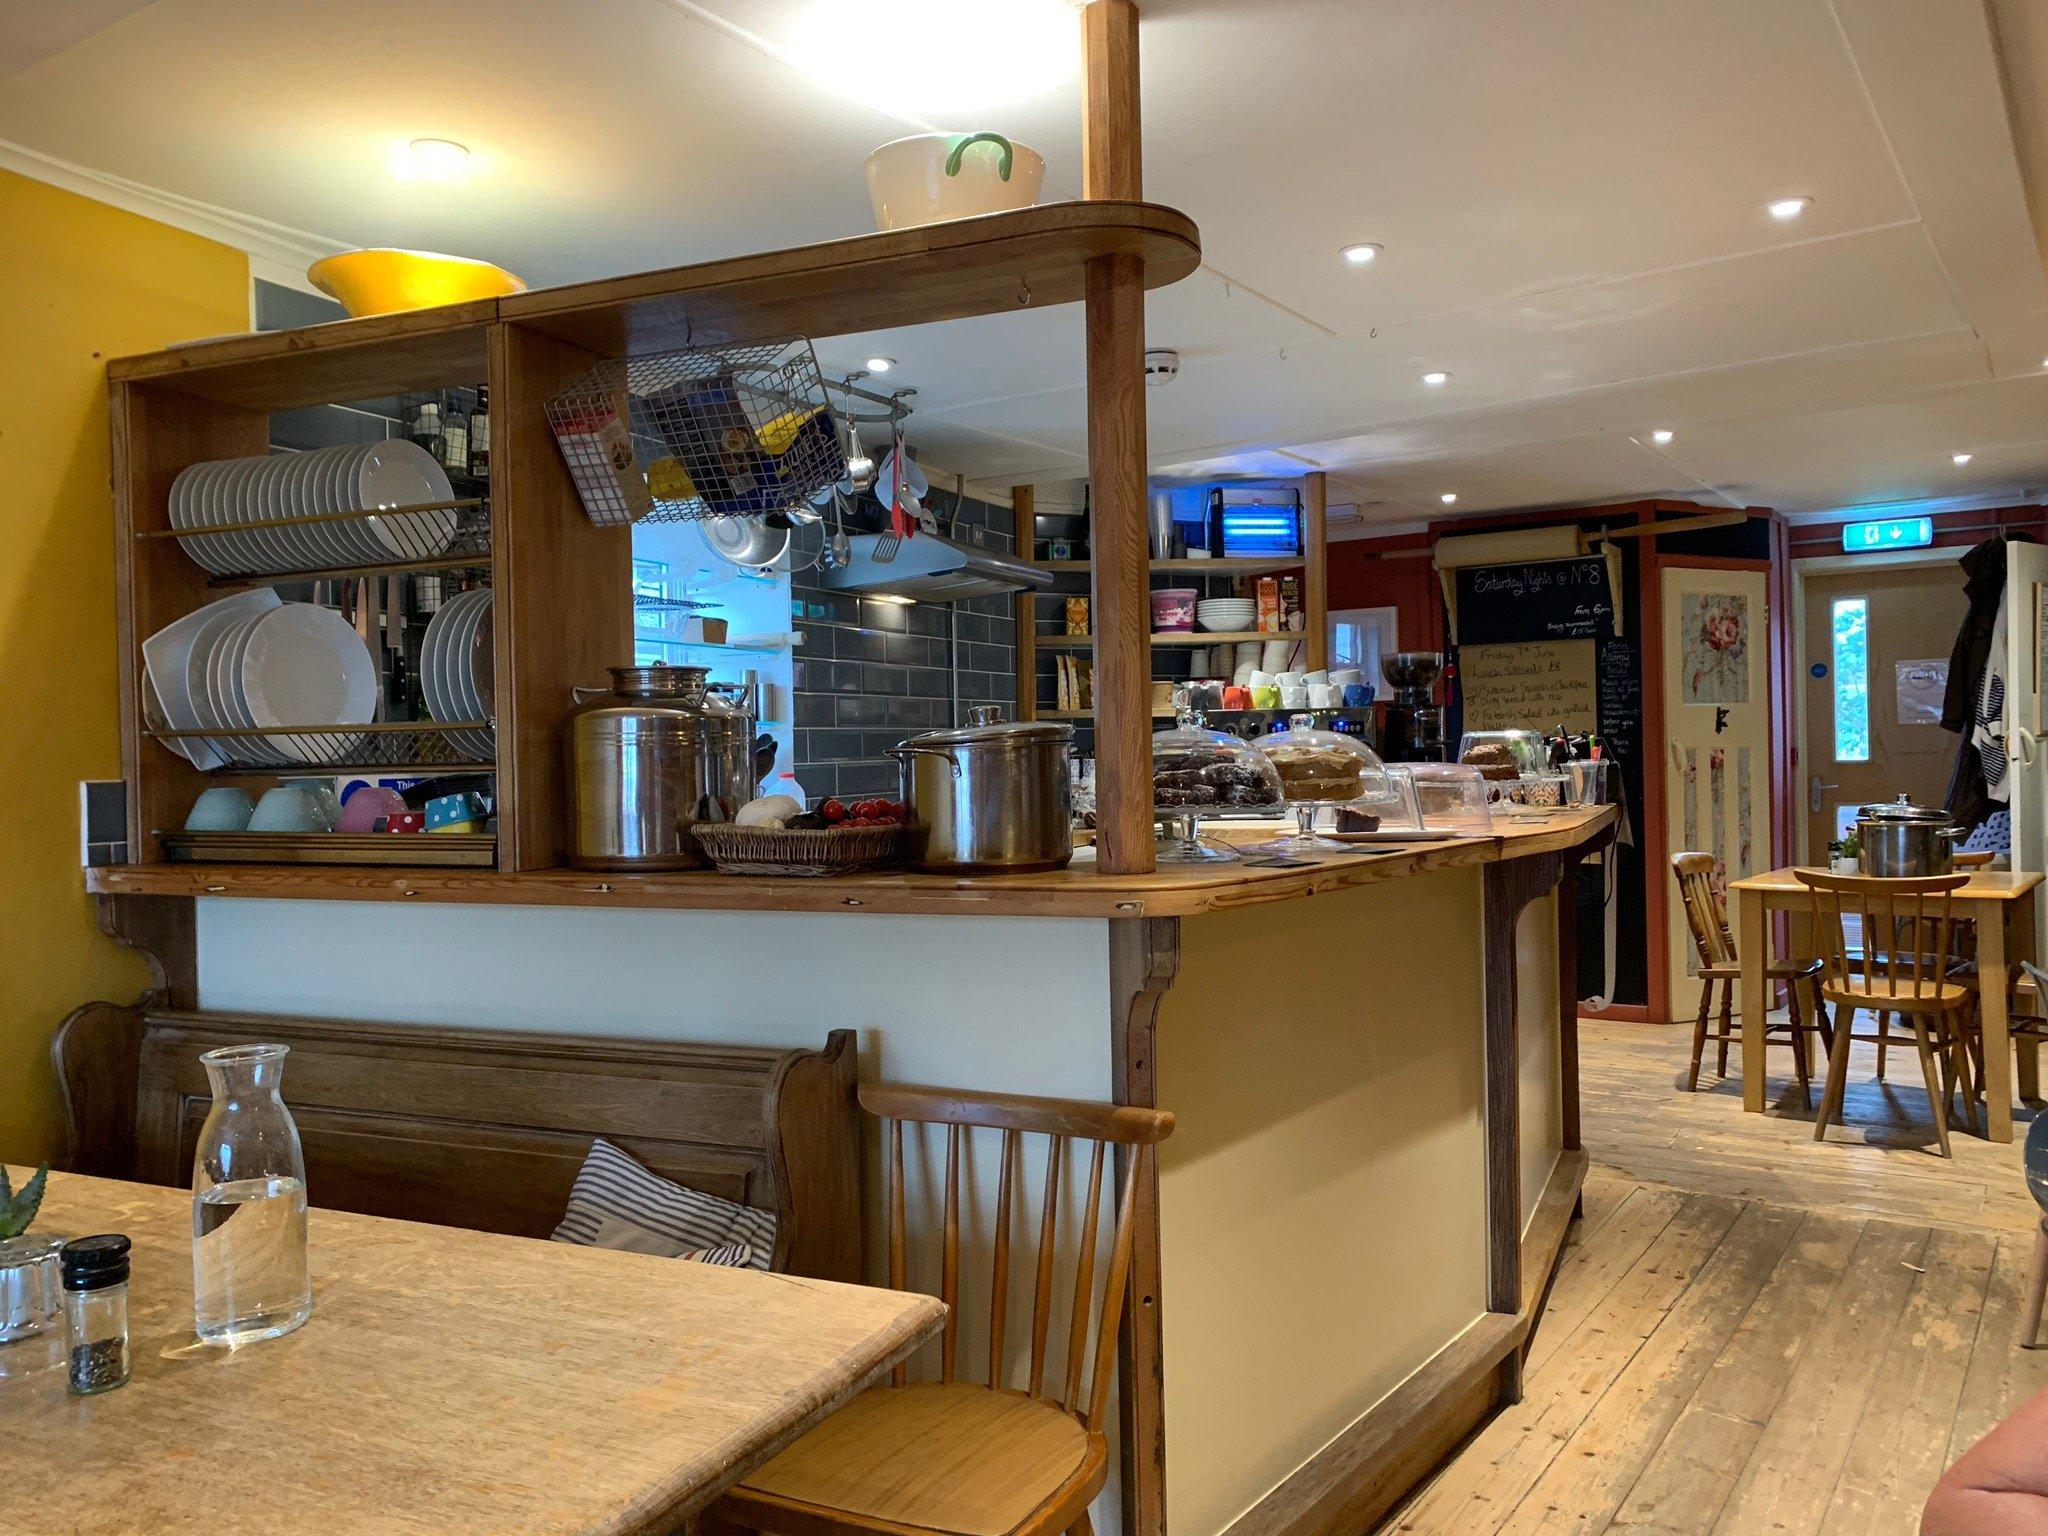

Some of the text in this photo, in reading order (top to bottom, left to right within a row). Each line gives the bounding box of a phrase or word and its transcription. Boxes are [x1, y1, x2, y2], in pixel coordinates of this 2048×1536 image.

[1474, 570, 1526, 596] Saturday
[1523, 568, 1552, 593] Nights
[1556, 571, 1567, 585] @
[1480, 649, 1513, 664] Friday
